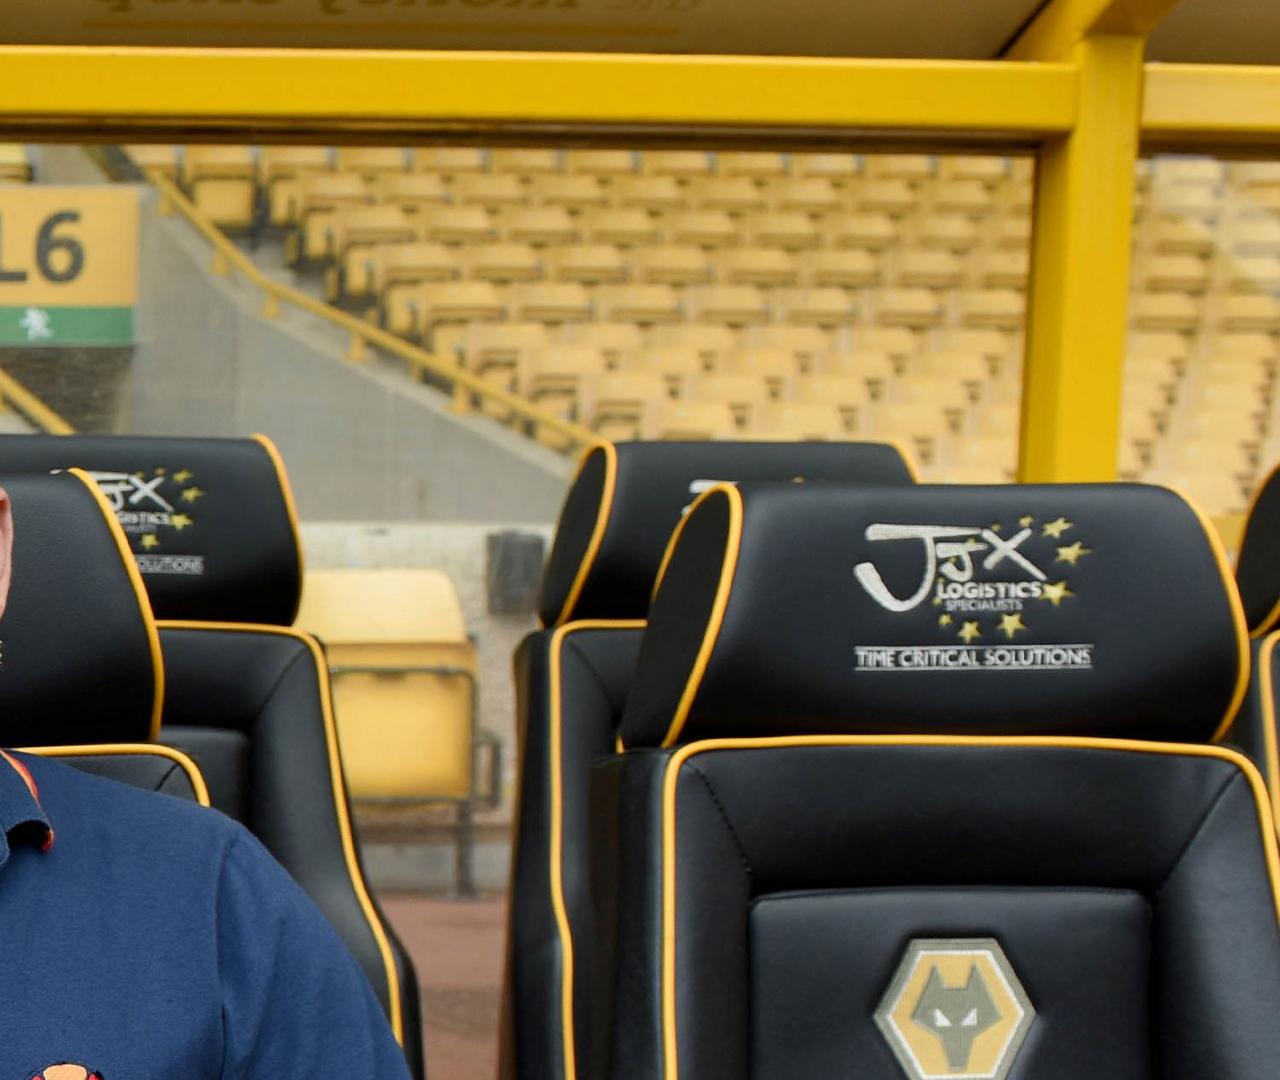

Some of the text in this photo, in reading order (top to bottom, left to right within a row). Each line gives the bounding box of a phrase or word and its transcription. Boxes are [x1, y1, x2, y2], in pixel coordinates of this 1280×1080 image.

[936, 580, 1043, 600] LOGISTICS
[945, 599, 1023, 612] SPECIALISTS
[856, 648, 1092, 668] TIME CRITICAL SOLUTIONS
